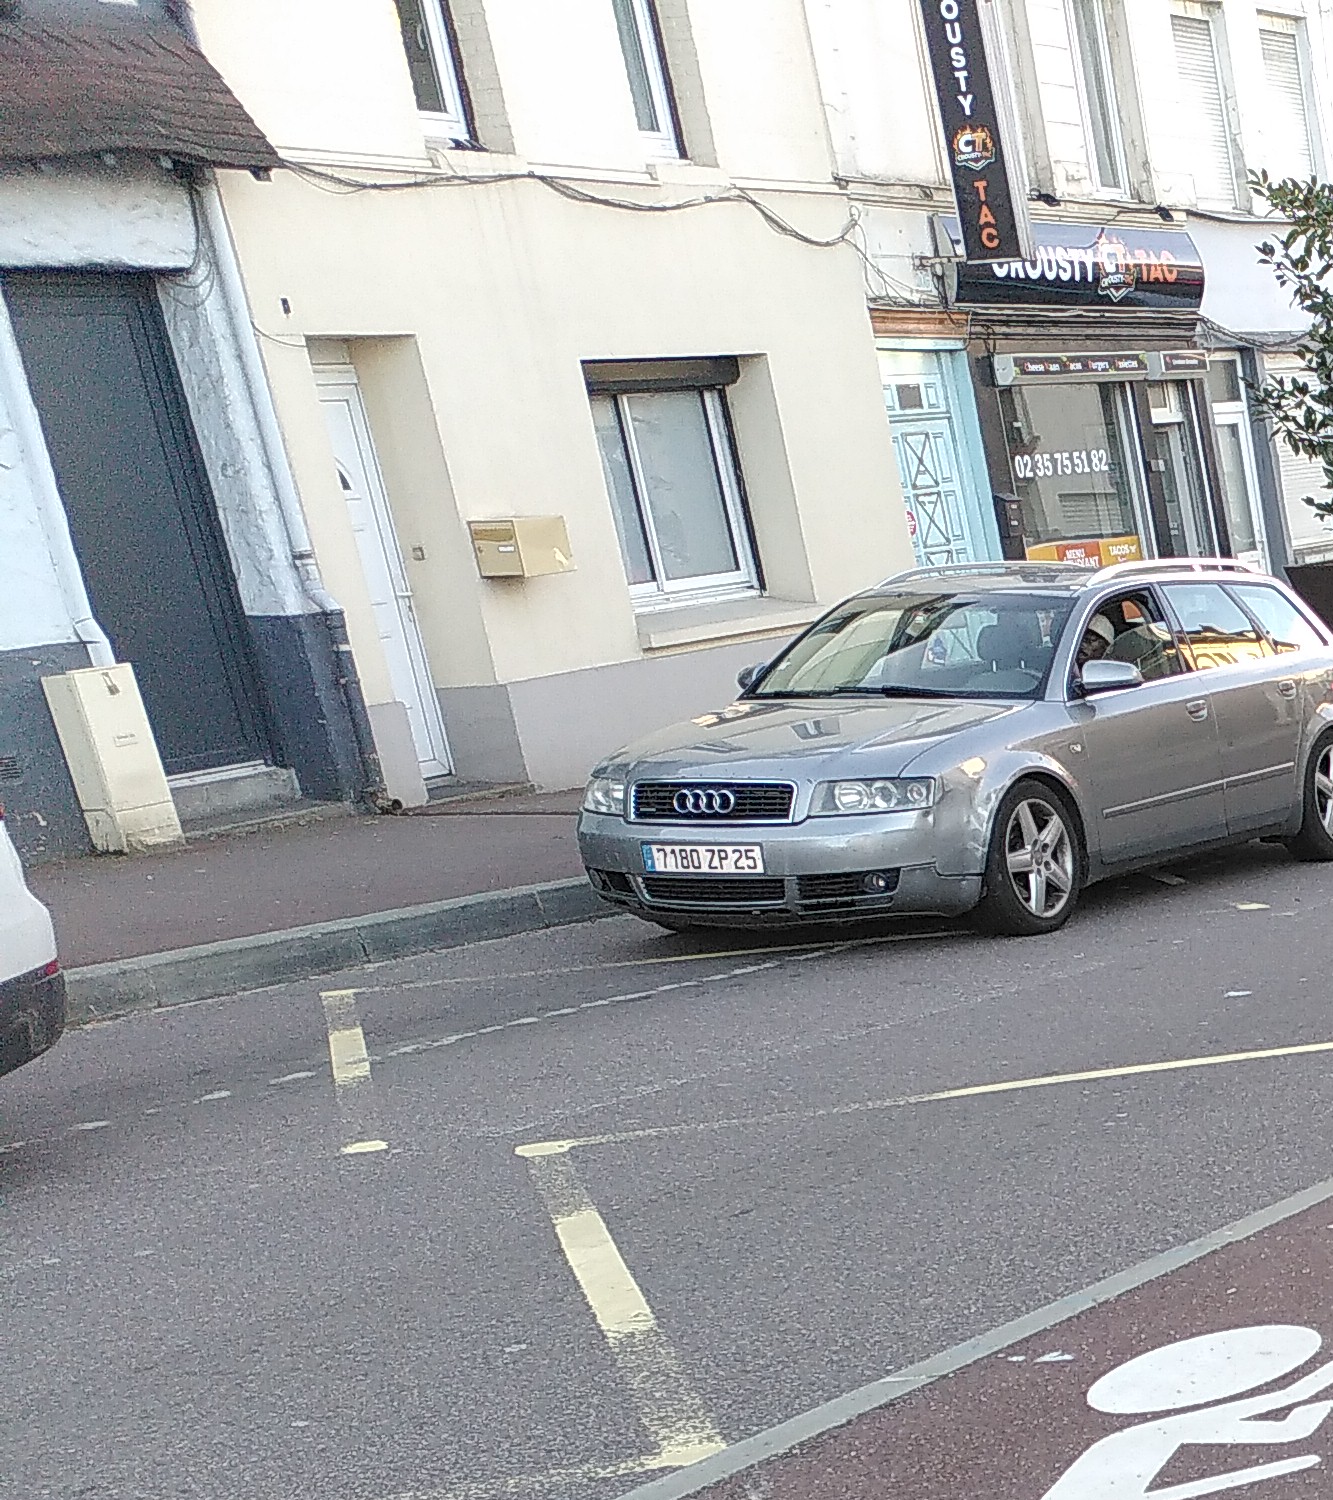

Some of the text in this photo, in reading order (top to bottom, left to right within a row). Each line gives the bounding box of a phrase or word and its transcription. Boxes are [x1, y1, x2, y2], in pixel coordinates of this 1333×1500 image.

[973, 179, 1001, 249] TAC
[1014, 449, 1109, 479] 02 35 75 51 82
[656, 848, 758, 870] 7180 ZP 25
